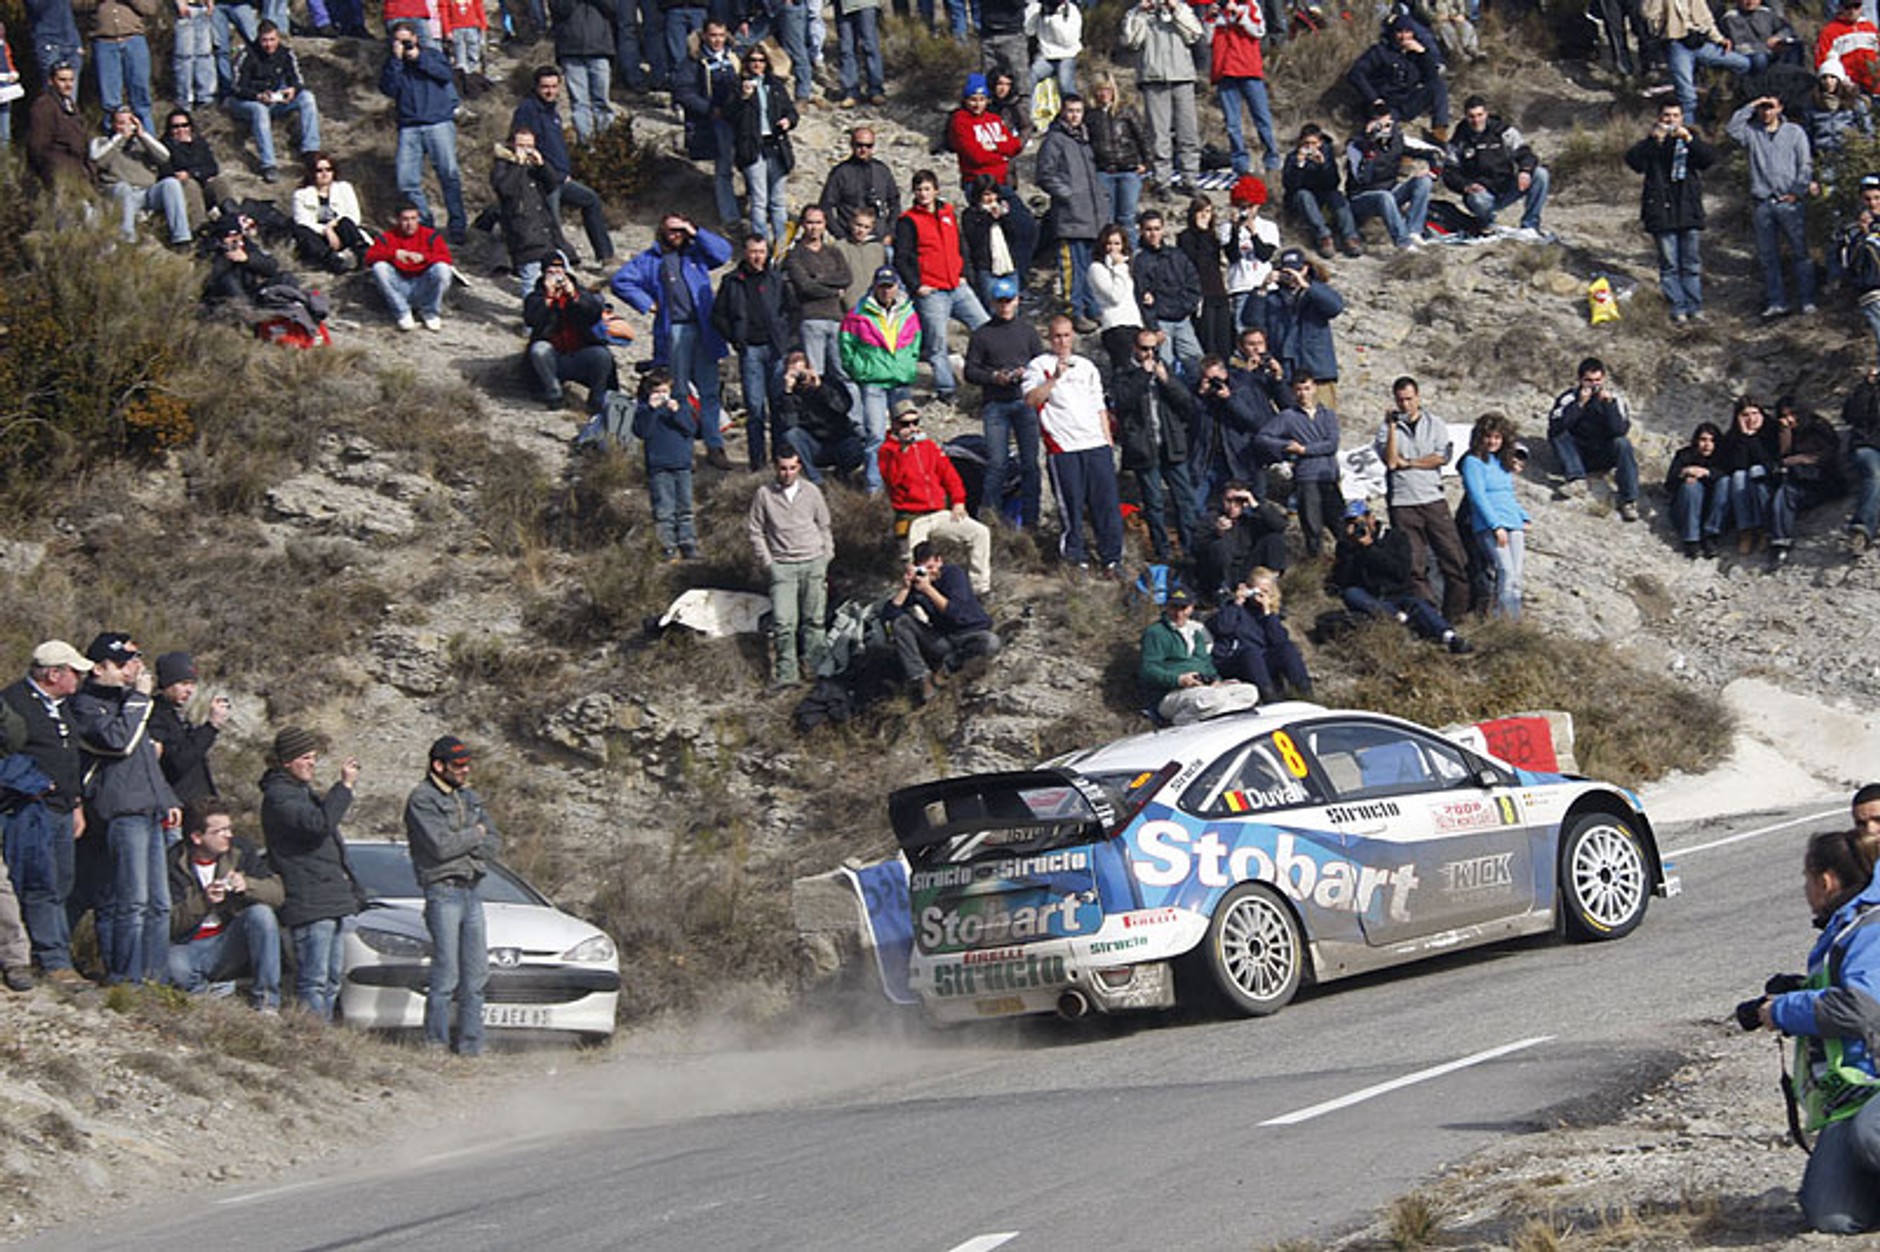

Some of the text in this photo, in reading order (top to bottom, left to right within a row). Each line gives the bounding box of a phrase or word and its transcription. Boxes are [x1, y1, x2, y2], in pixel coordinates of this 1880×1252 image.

[1271, 728, 1309, 779] 8
[1244, 782, 1310, 810] Duval
[1499, 794, 1516, 825] 8
[1132, 819, 1419, 923] Stobart
[920, 892, 1082, 949] Stobart
